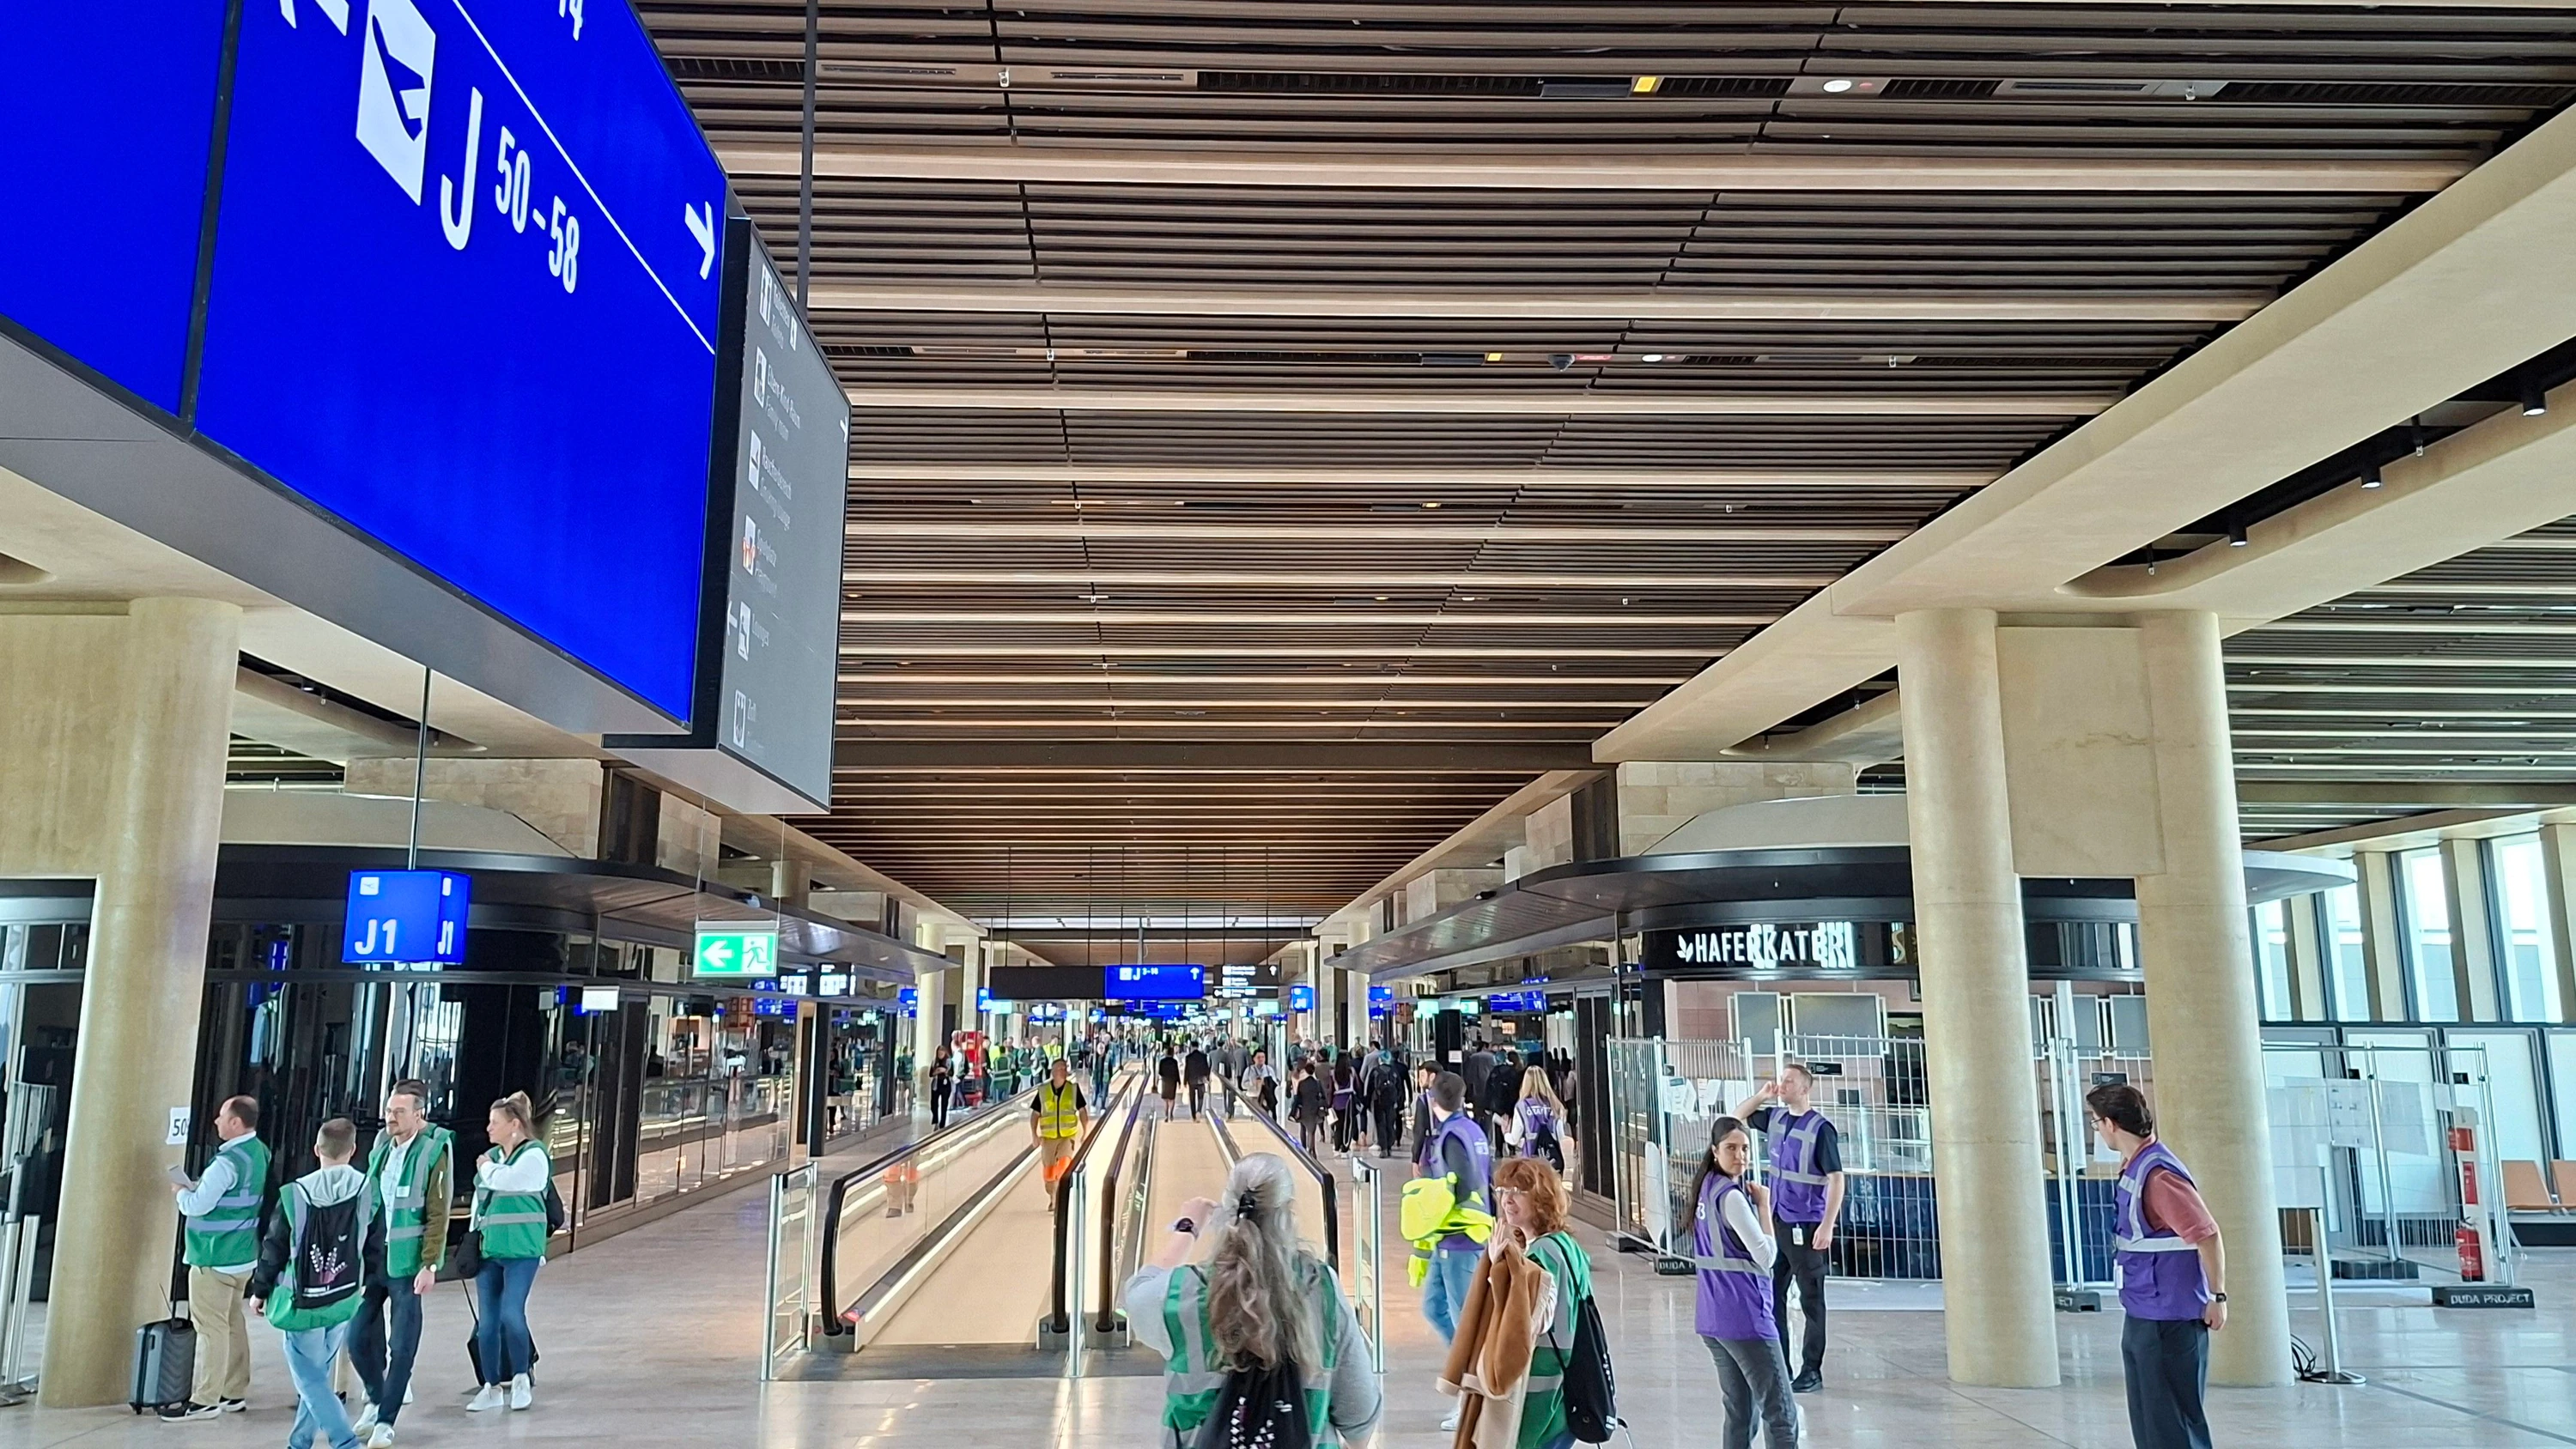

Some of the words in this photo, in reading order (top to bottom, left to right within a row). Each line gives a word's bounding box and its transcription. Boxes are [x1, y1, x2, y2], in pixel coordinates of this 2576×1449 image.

[440, 87, 483, 250] J
[354, 919, 398, 955] J1
[437, 920, 454, 955] J1
[2451, 1294, 2480, 1304] DUDA
[2484, 1294, 2530, 1304] PROJECT
